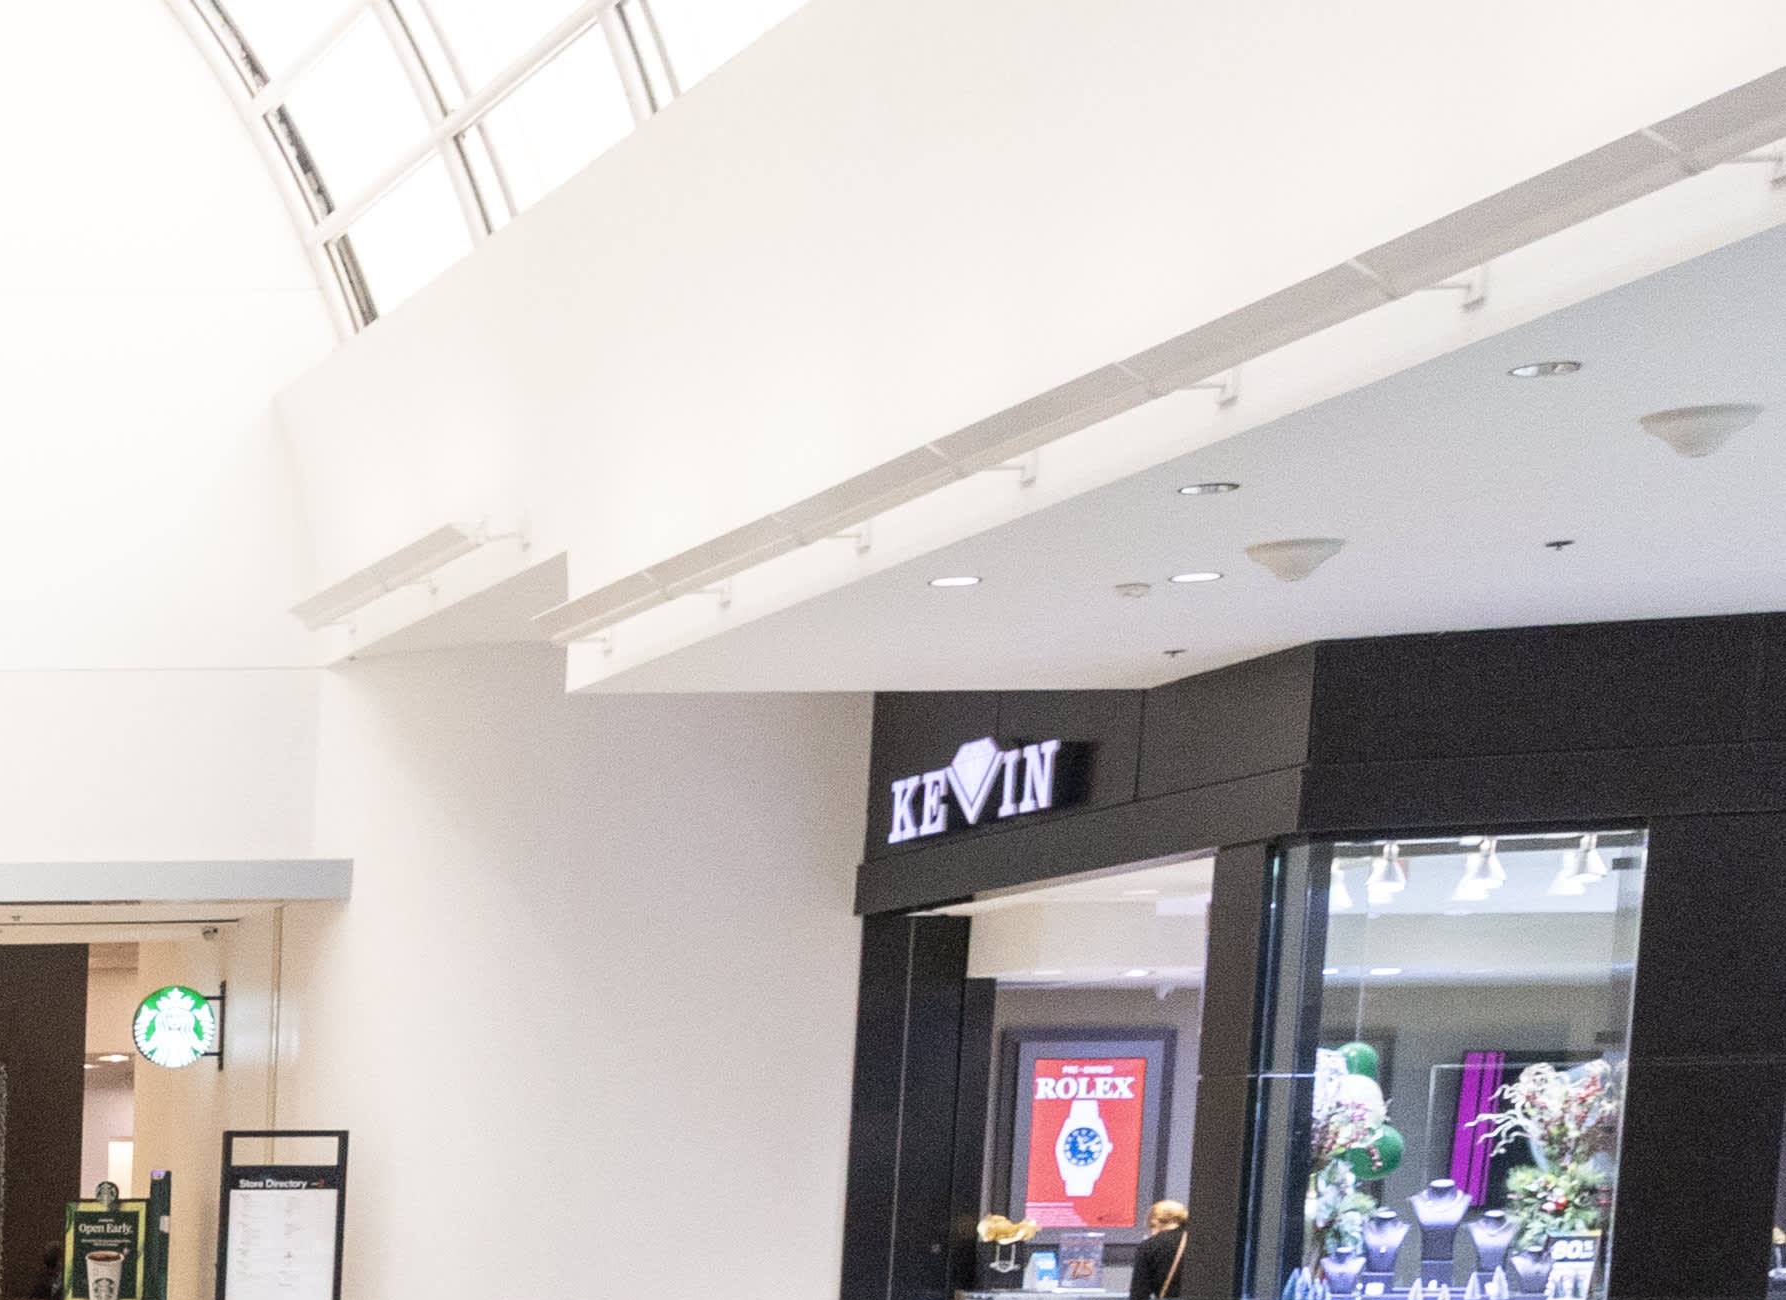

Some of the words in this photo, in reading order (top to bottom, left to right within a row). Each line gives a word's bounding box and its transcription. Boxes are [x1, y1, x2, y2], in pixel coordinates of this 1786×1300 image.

[887, 737, 1062, 845] KEVIN
[1034, 1076, 1136, 1100] ROLEX
[265, 1178, 308, 1189] Directory
[78, 1223, 105, 1235] Open
